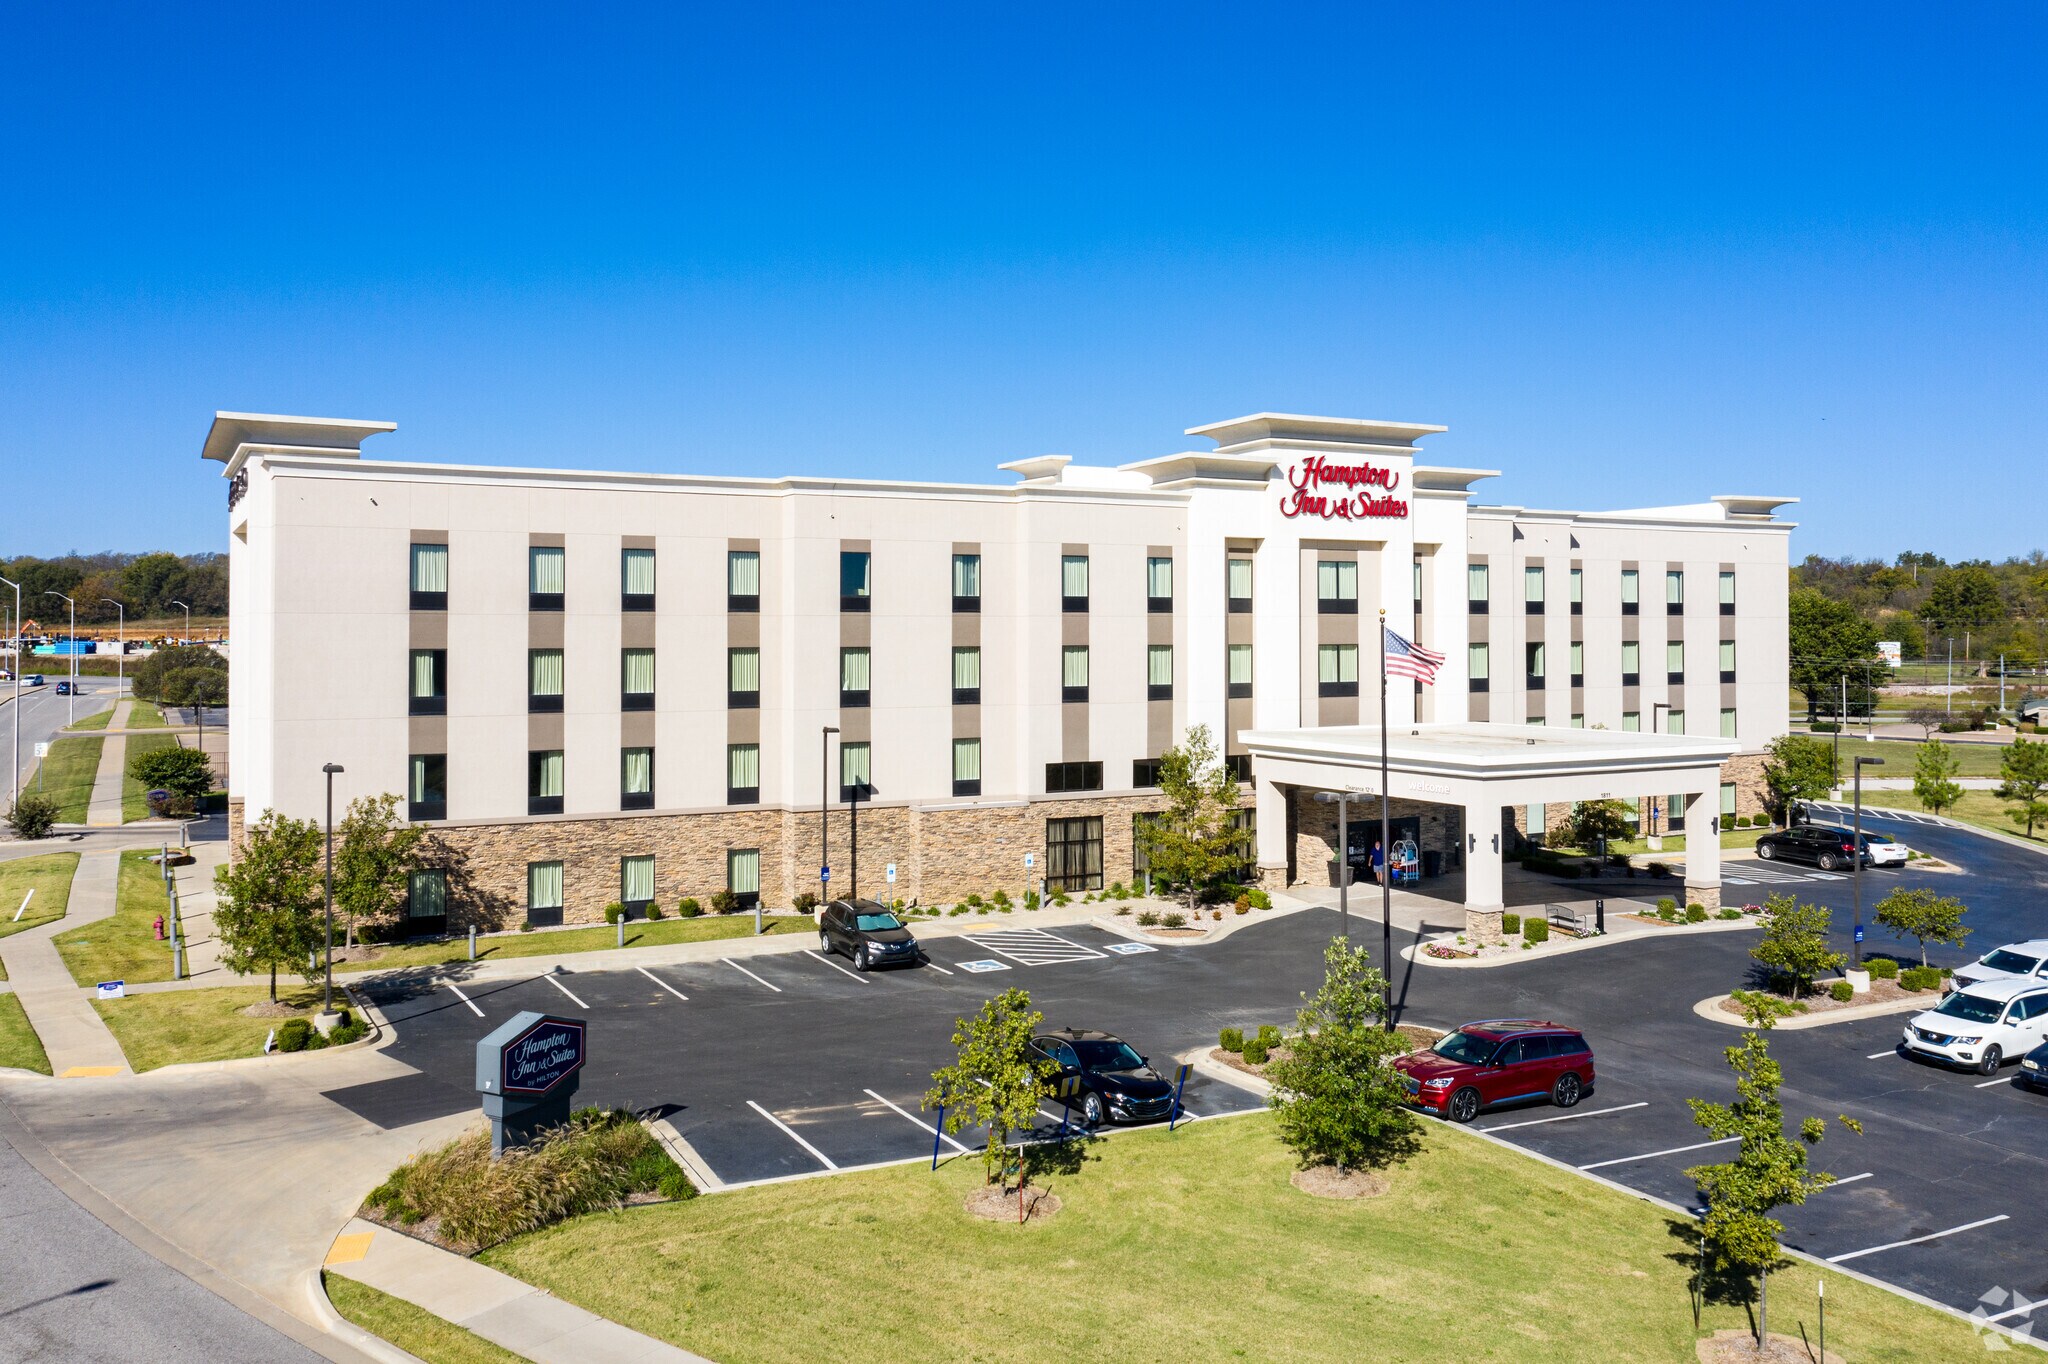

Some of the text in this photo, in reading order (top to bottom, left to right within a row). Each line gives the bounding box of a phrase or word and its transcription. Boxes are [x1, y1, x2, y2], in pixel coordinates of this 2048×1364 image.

[1289, 455, 1399, 491] Hampton
[1280, 488, 1408, 521] Inn & Suites
[1409, 780, 1450, 794] welcome
[515, 1033, 570, 1062] Hampton
[512, 1049, 576, 1079] Inn & Suites
[537, 1071, 559, 1082] HILTON
